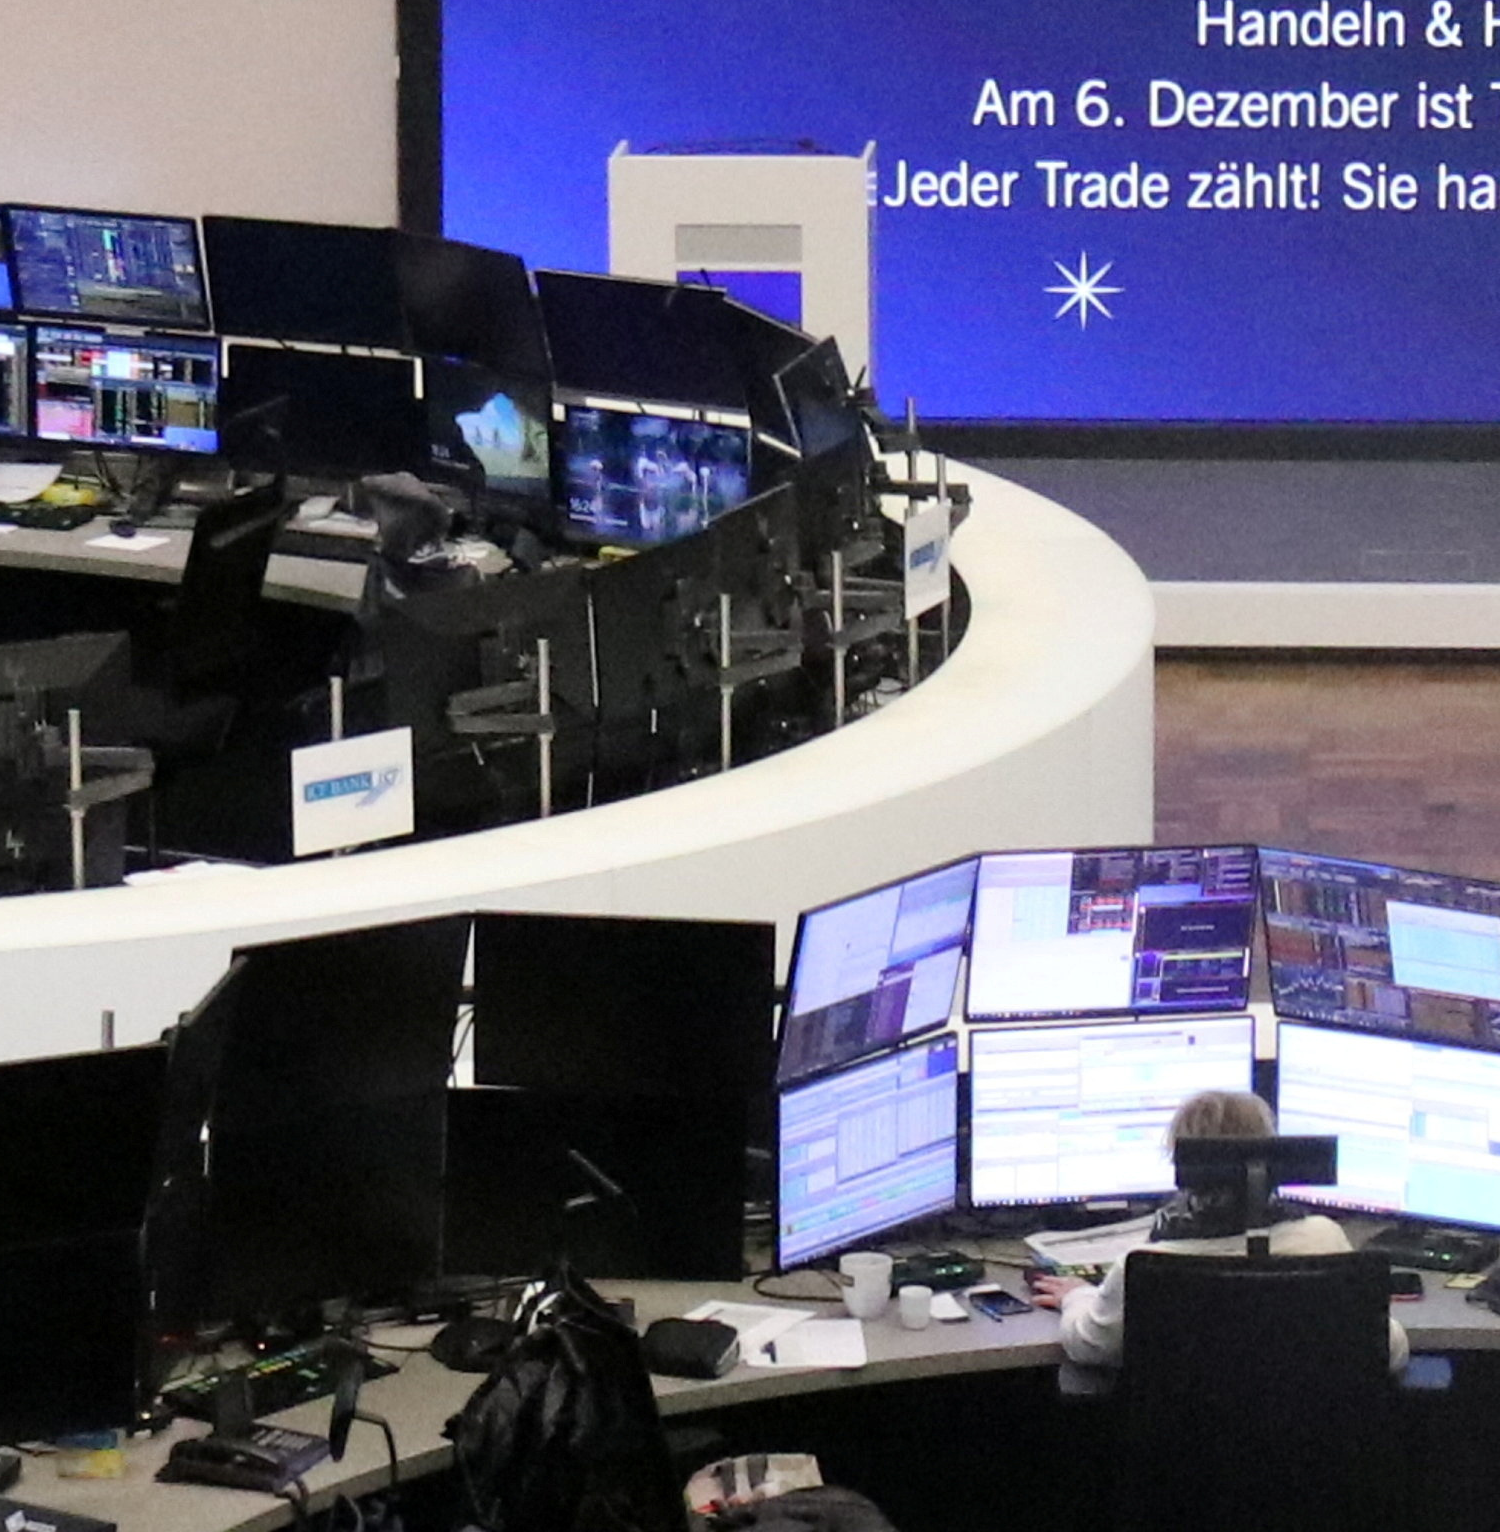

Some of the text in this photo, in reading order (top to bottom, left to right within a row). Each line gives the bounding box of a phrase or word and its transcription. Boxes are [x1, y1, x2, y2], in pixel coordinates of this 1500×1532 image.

[1425, 0, 1463, 48] &
[972, 78, 1055, 126] Am
[1075, 79, 1124, 128] 6.
[1149, 79, 1400, 129] Dezember
[1418, 81, 1473, 129] ist
[883, 159, 1020, 208] Jeder
[1035, 160, 1170, 209] Trade
[1187, 161, 1320, 210] zählt!
[1342, 161, 1418, 210] Sie
